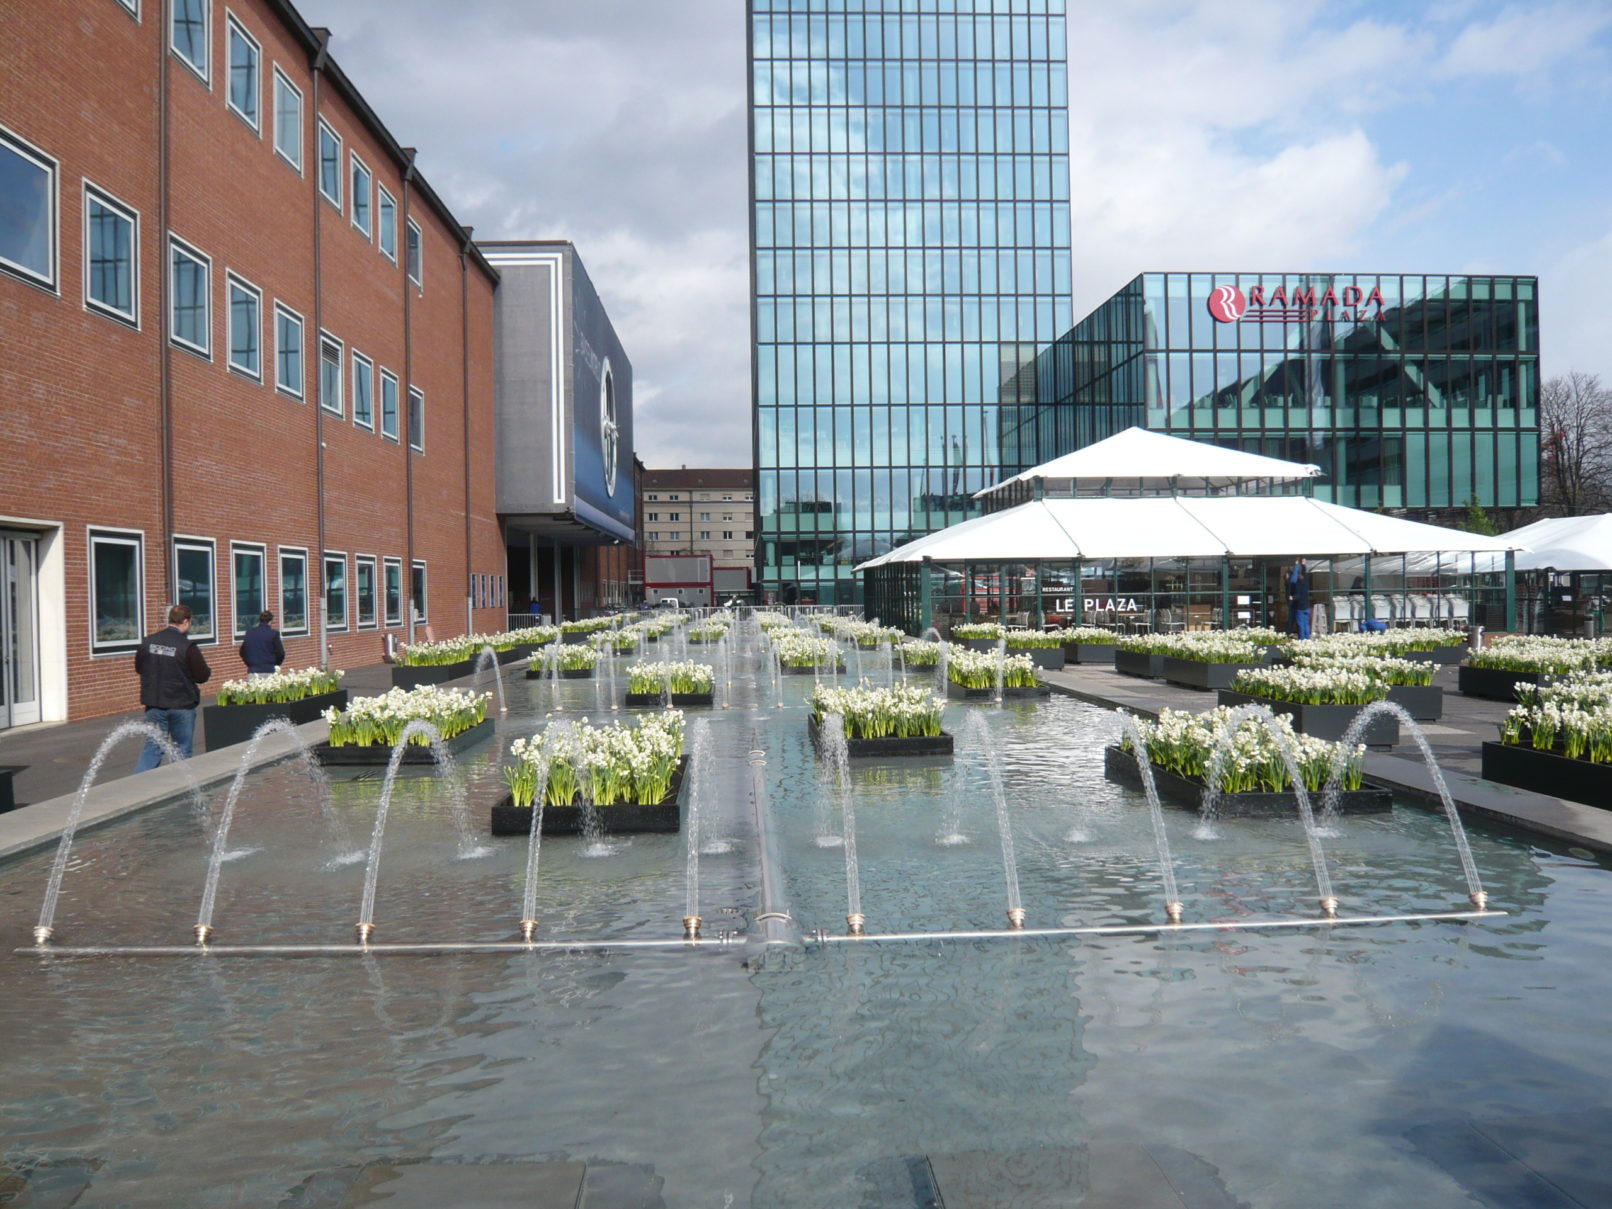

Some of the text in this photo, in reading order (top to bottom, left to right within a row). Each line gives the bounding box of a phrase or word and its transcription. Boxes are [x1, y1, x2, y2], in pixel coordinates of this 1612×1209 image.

[1250, 285, 1386, 307] RAMADA
[1309, 309, 1387, 322] PLAZA
[1056, 598, 1138, 613] LE PLAZA
